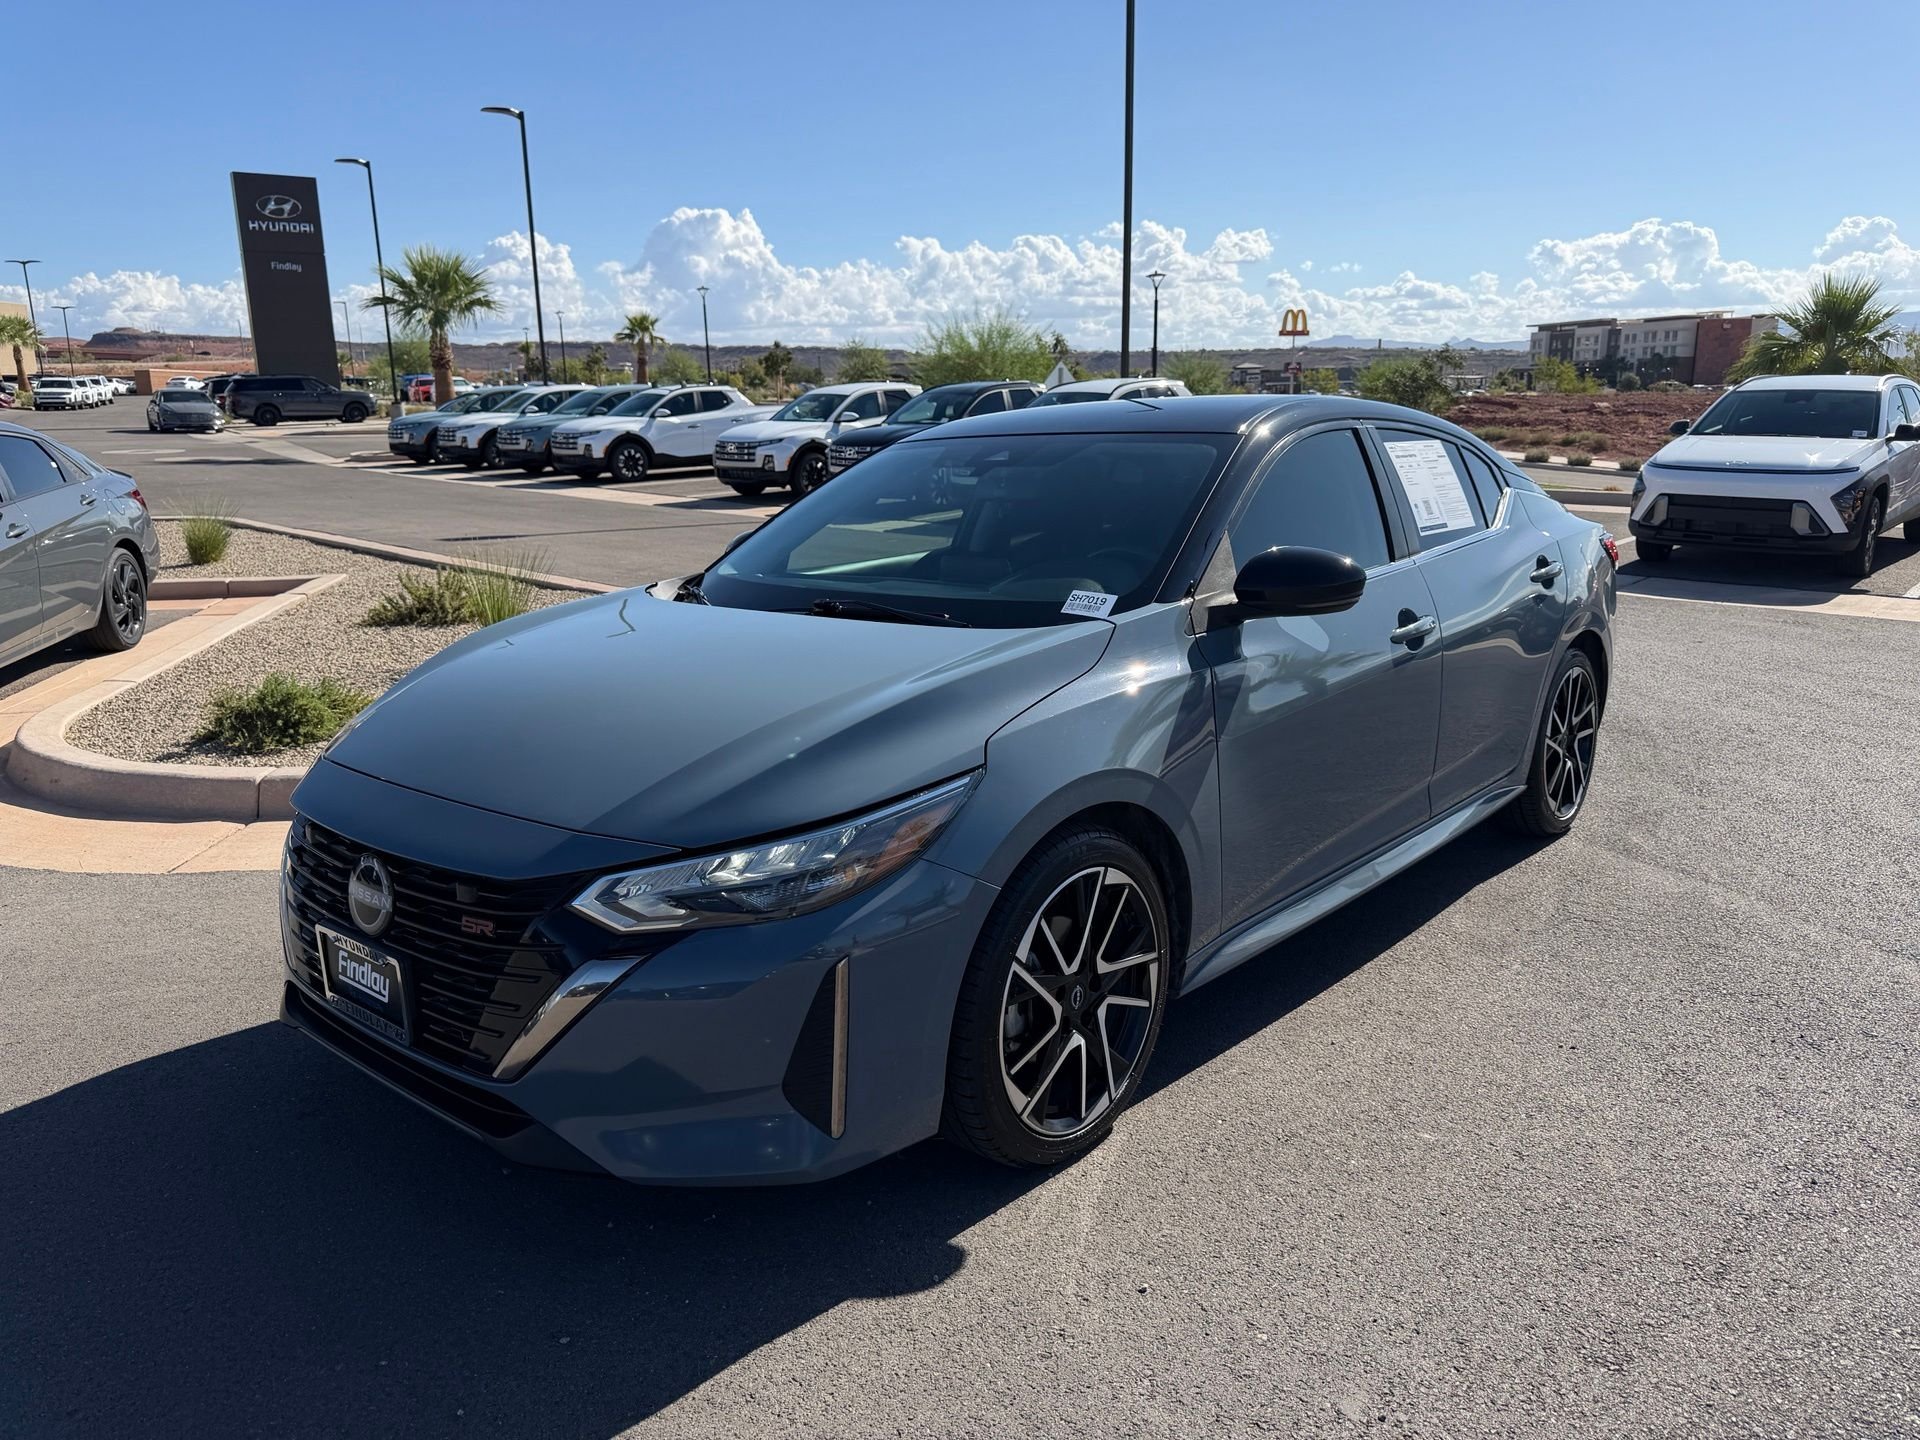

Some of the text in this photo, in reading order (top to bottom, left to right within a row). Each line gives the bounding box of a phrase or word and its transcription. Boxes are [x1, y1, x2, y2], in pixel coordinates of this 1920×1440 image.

[248, 220, 315, 234] HYUNDAI
[271, 261, 302, 272] Findlay
[1069, 593, 1108, 606] SH7019
[461, 914, 496, 938] SR
[336, 934, 378, 962] HYUNDAI
[338, 949, 390, 1003] Findlay
